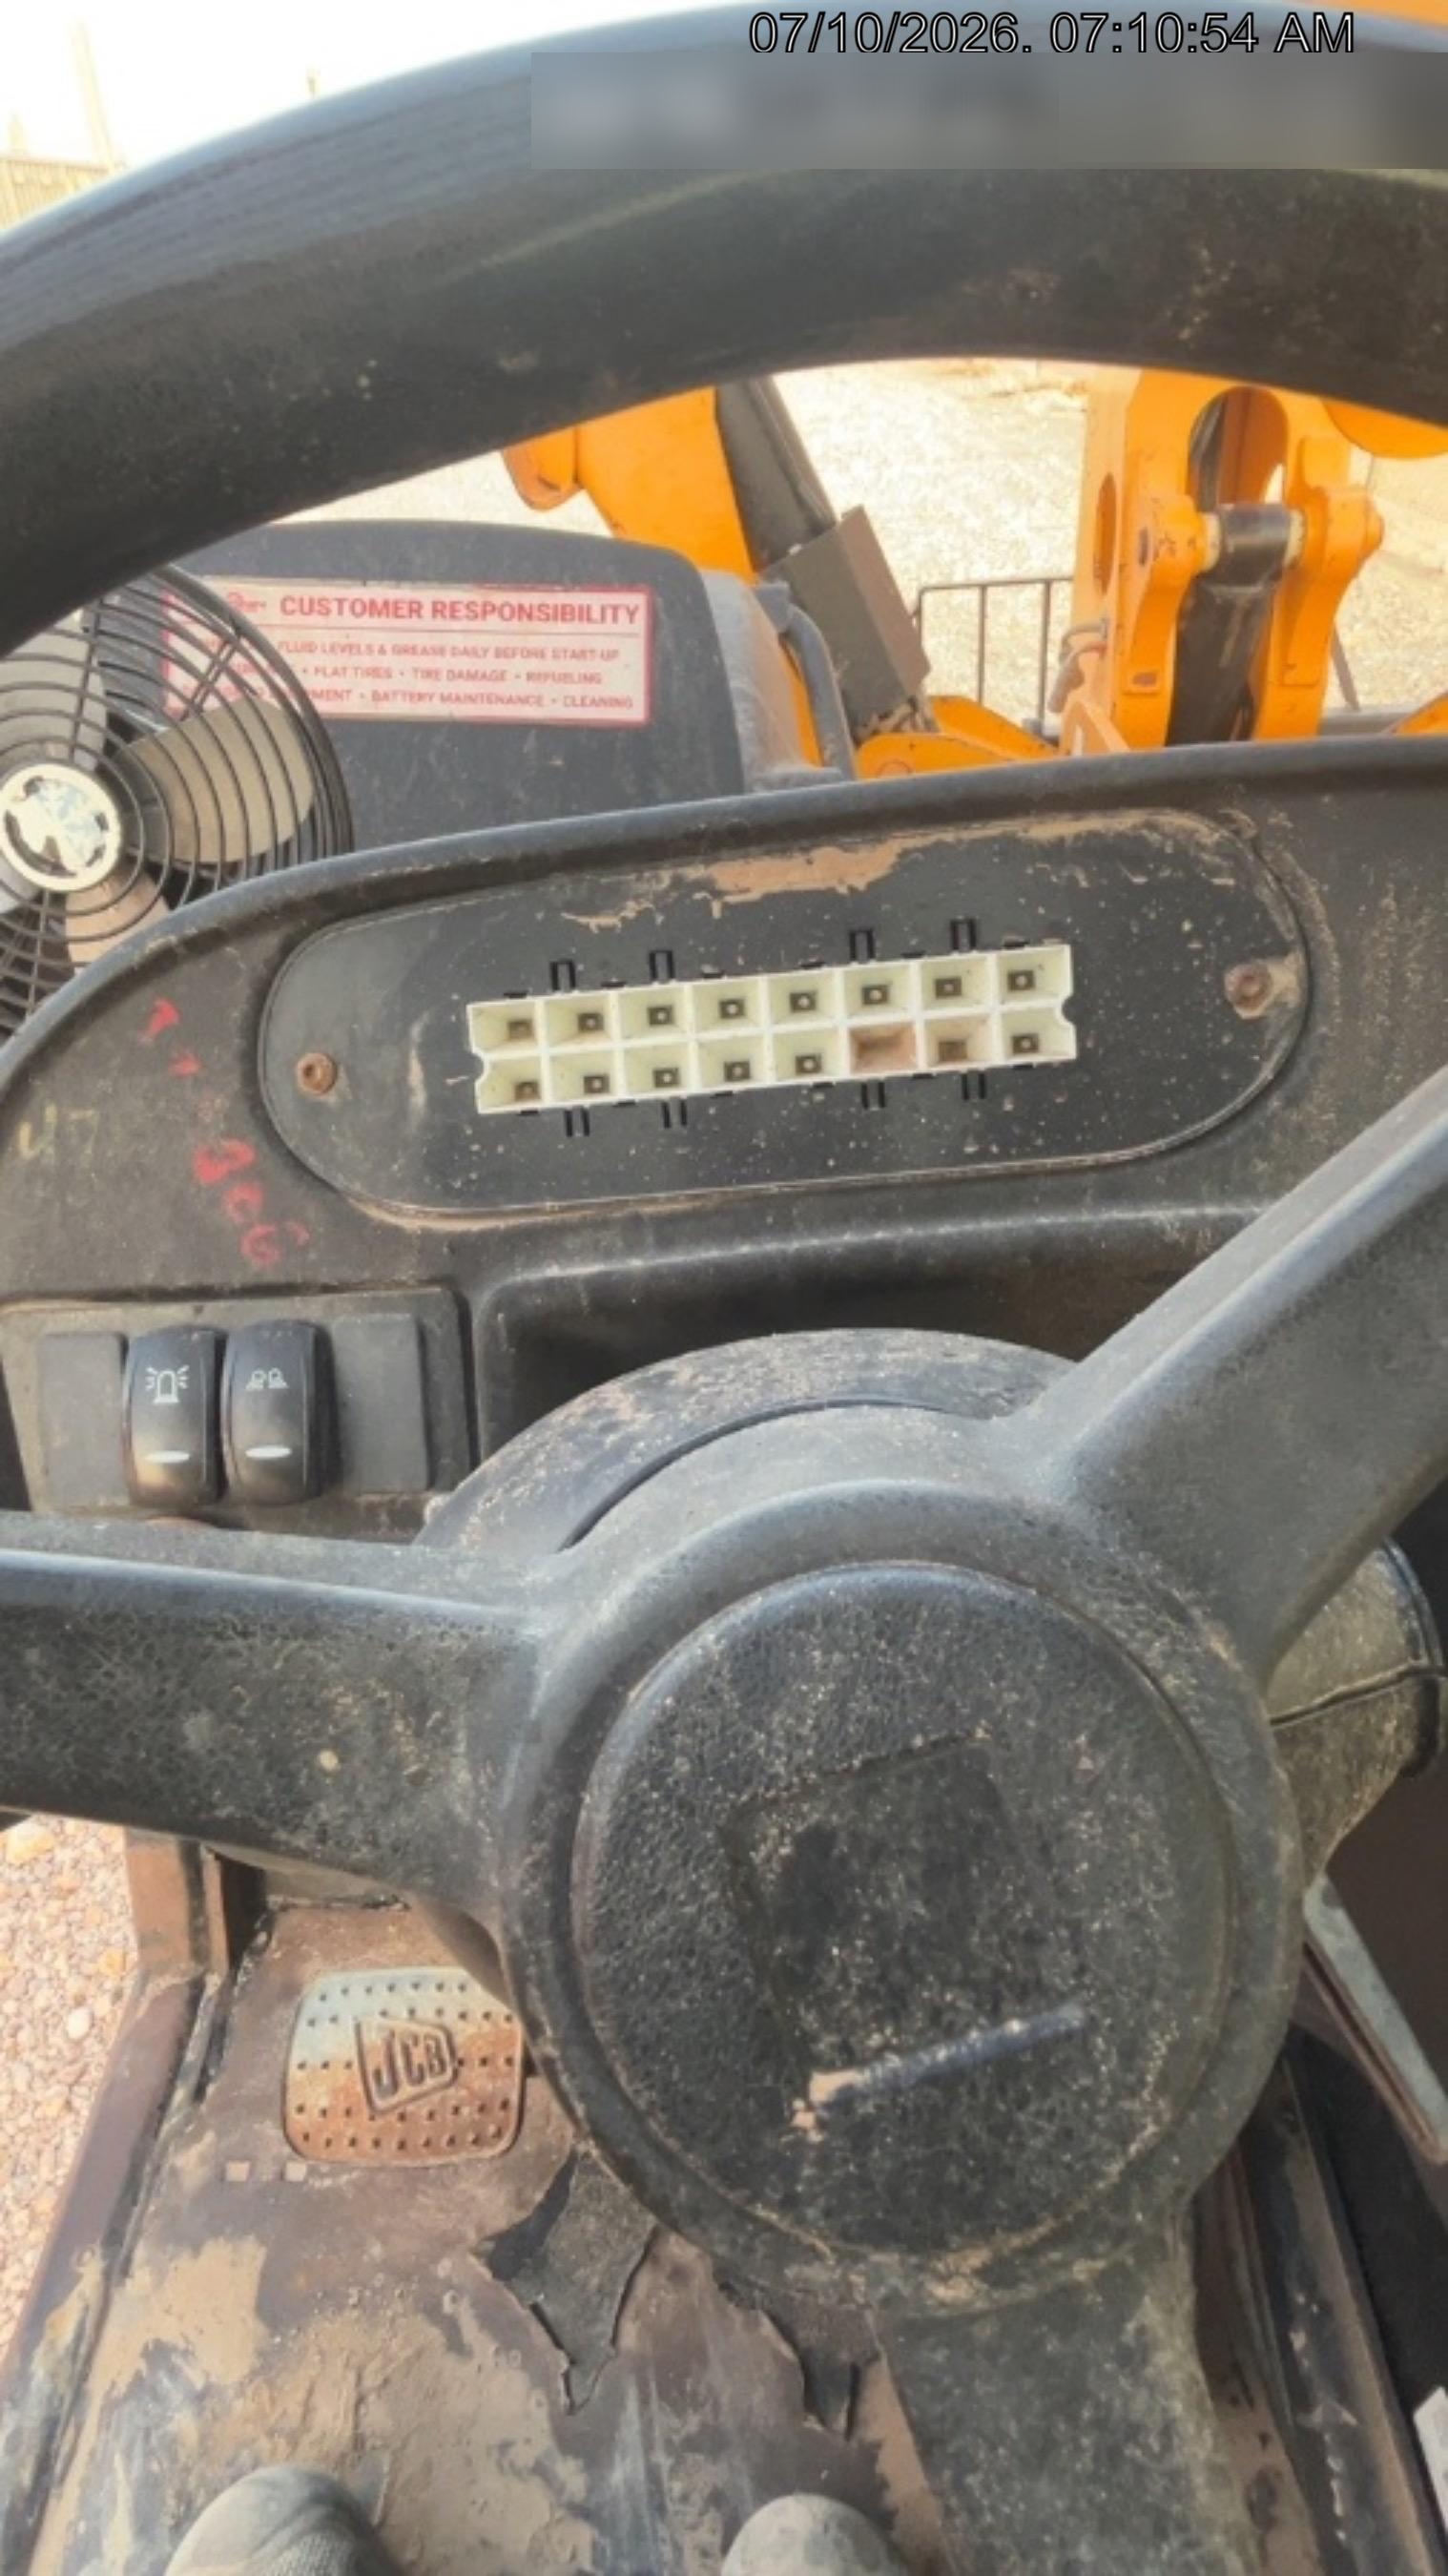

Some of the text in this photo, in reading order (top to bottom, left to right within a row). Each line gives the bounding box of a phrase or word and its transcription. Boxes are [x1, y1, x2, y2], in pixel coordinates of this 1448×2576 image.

[279, 594, 424, 620] CUSTOMER
[431, 600, 640, 625] RESPONSIBILITY
[322, 641, 375, 656] LEVELS
[378, 643, 387, 656] &
[391, 644, 445, 658] GREASE
[451, 646, 492, 659] DAILY
[494, 646, 548, 660] BEFORE
[314, 667, 348, 679] FLAT
[352, 667, 393, 680] TIRES
[412, 667, 442, 681] TIRE
[445, 670, 507, 682] DAMAGE
[371, 690, 633, 710] BATTERY MAINTENANCE CLEANING
[371, 2027, 447, 2098] JCB
